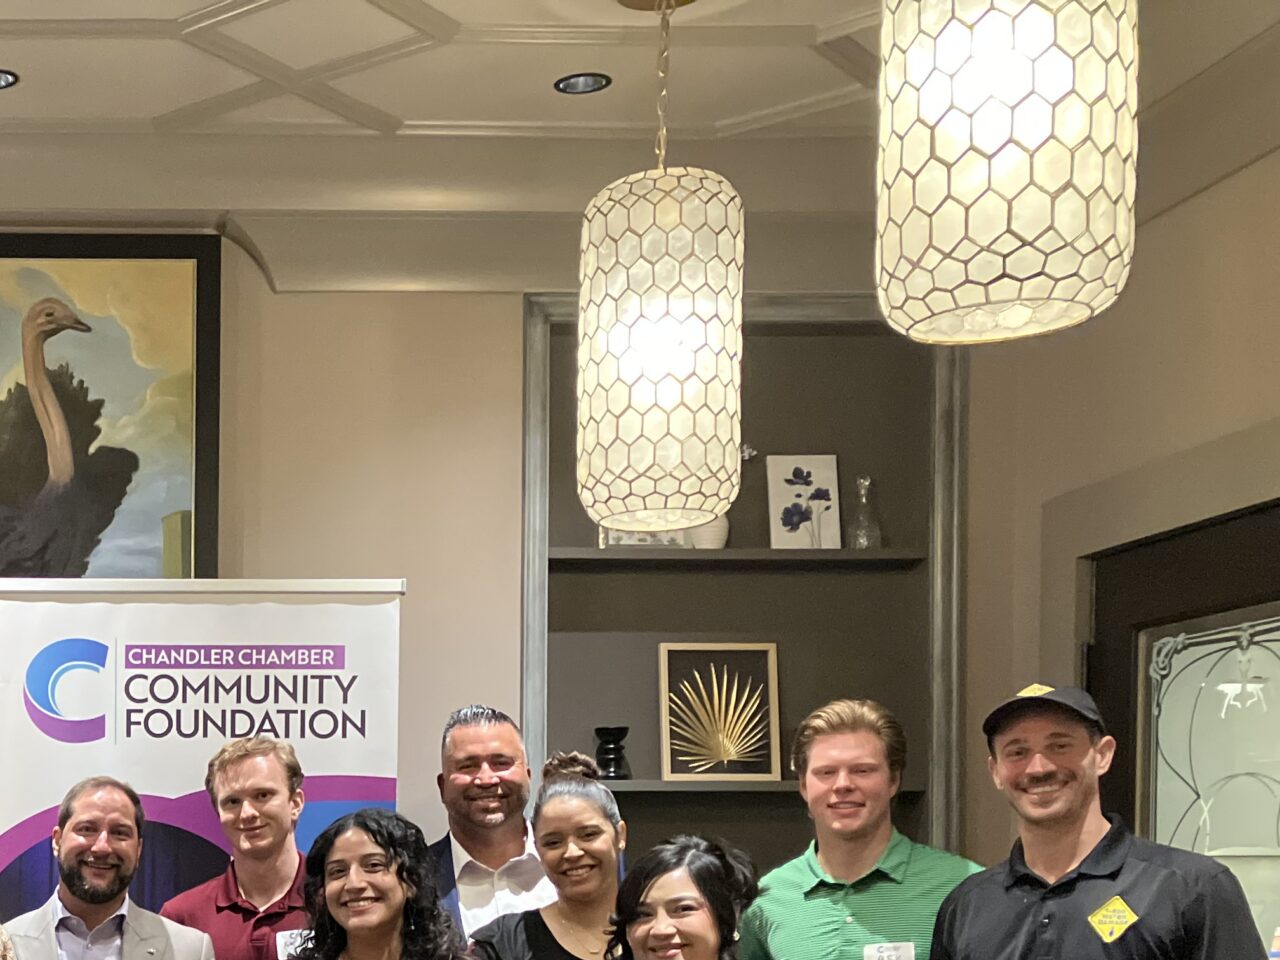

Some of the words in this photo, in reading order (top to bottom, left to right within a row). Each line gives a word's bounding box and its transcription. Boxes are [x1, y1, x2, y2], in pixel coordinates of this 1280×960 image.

[128, 648, 235, 666] CHANDLER
[238, 648, 335, 666] CHAMBER
[124, 674, 359, 705] COMMUNITY
[124, 708, 367, 739] FOUNDATION
